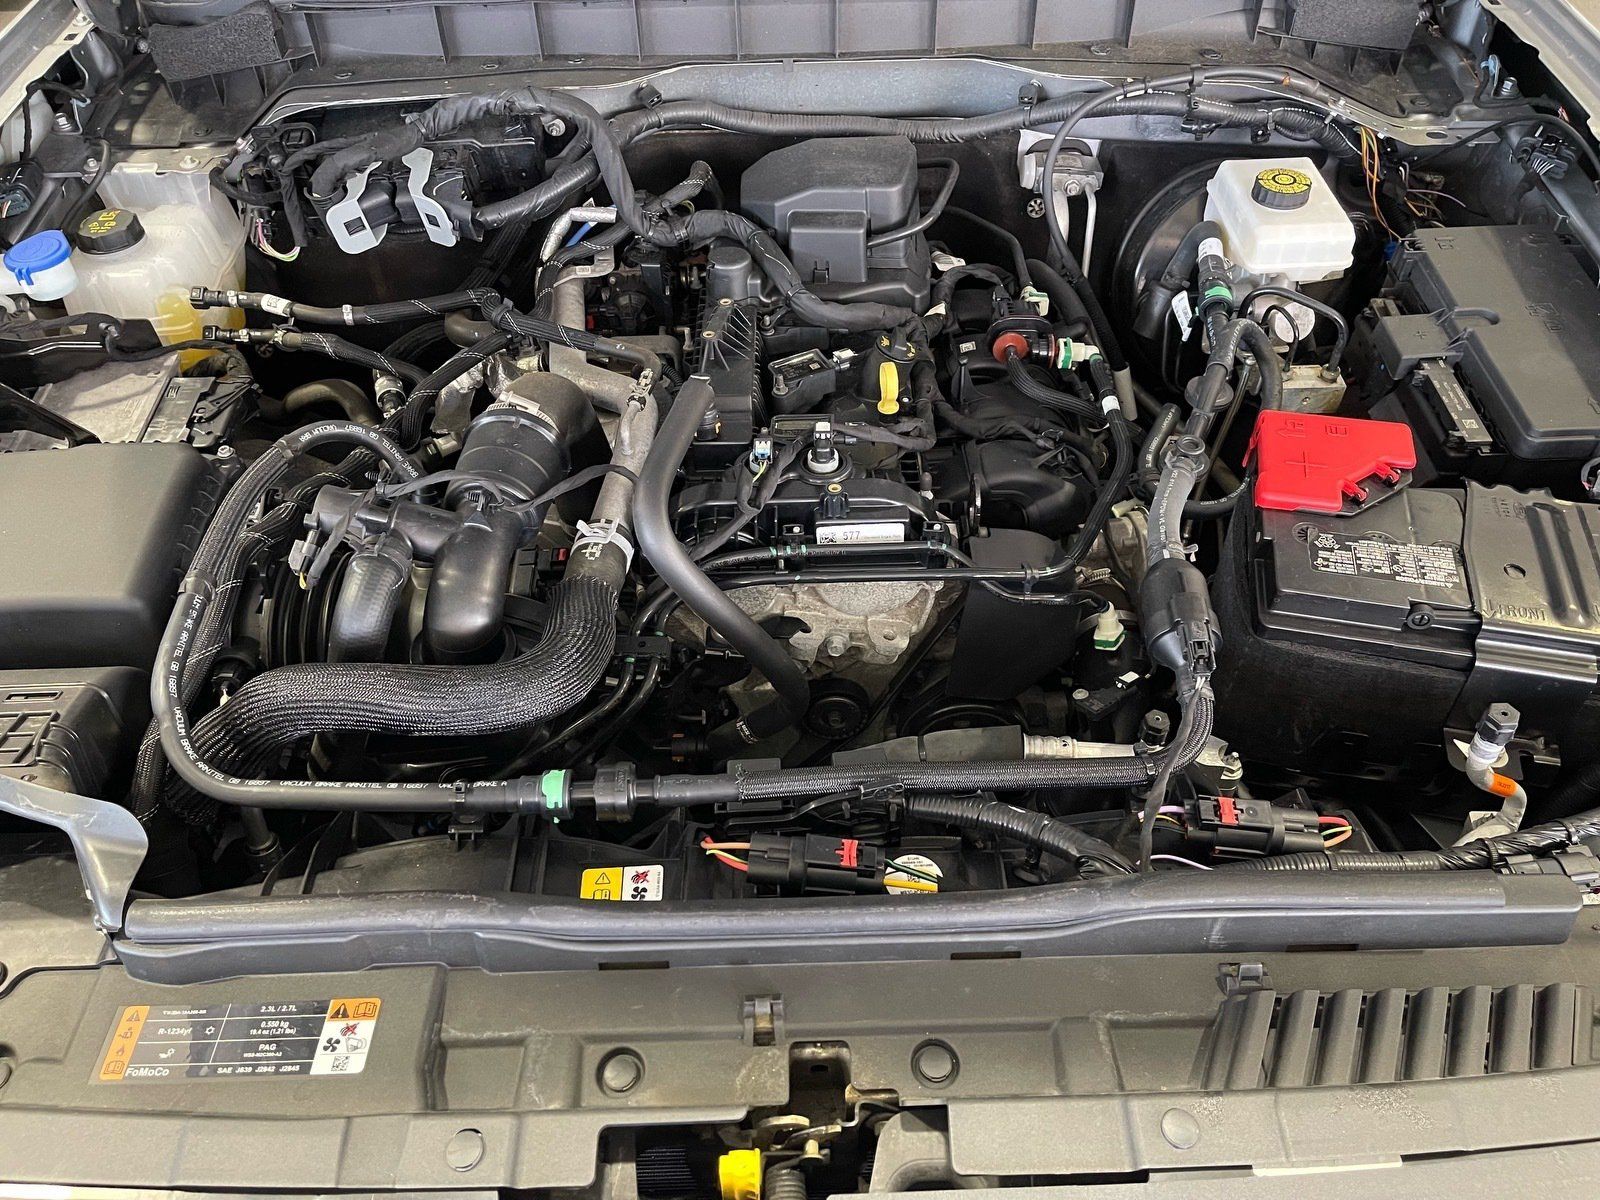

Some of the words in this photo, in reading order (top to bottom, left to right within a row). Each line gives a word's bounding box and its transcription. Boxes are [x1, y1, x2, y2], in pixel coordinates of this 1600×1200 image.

[344, 424, 366, 434] 16897
[368, 431, 379, 440] GB
[402, 461, 419, 478] BRAKE
[843, 531, 860, 541] 577
[174, 630, 189, 657] ARNITEL
[170, 661, 179, 671] GB
[169, 675, 177, 697] 16897
[173, 707, 186, 737] VACUUM
[180, 738, 199, 761] BRAKE
[196, 761, 225, 782] ARNITEL
[228, 777, 241, 785] GB
[260, 1005, 276, 1013] 2.3L
[281, 1004, 297, 1012] 2.7L
[260, 1020, 280, 1028] 0.550
[280, 1020, 290, 1029] kg
[158, 1027, 193, 1036] R-1234yf
[258, 1043, 277, 1051] PAG
[125, 1067, 170, 1077] FoMoCo
